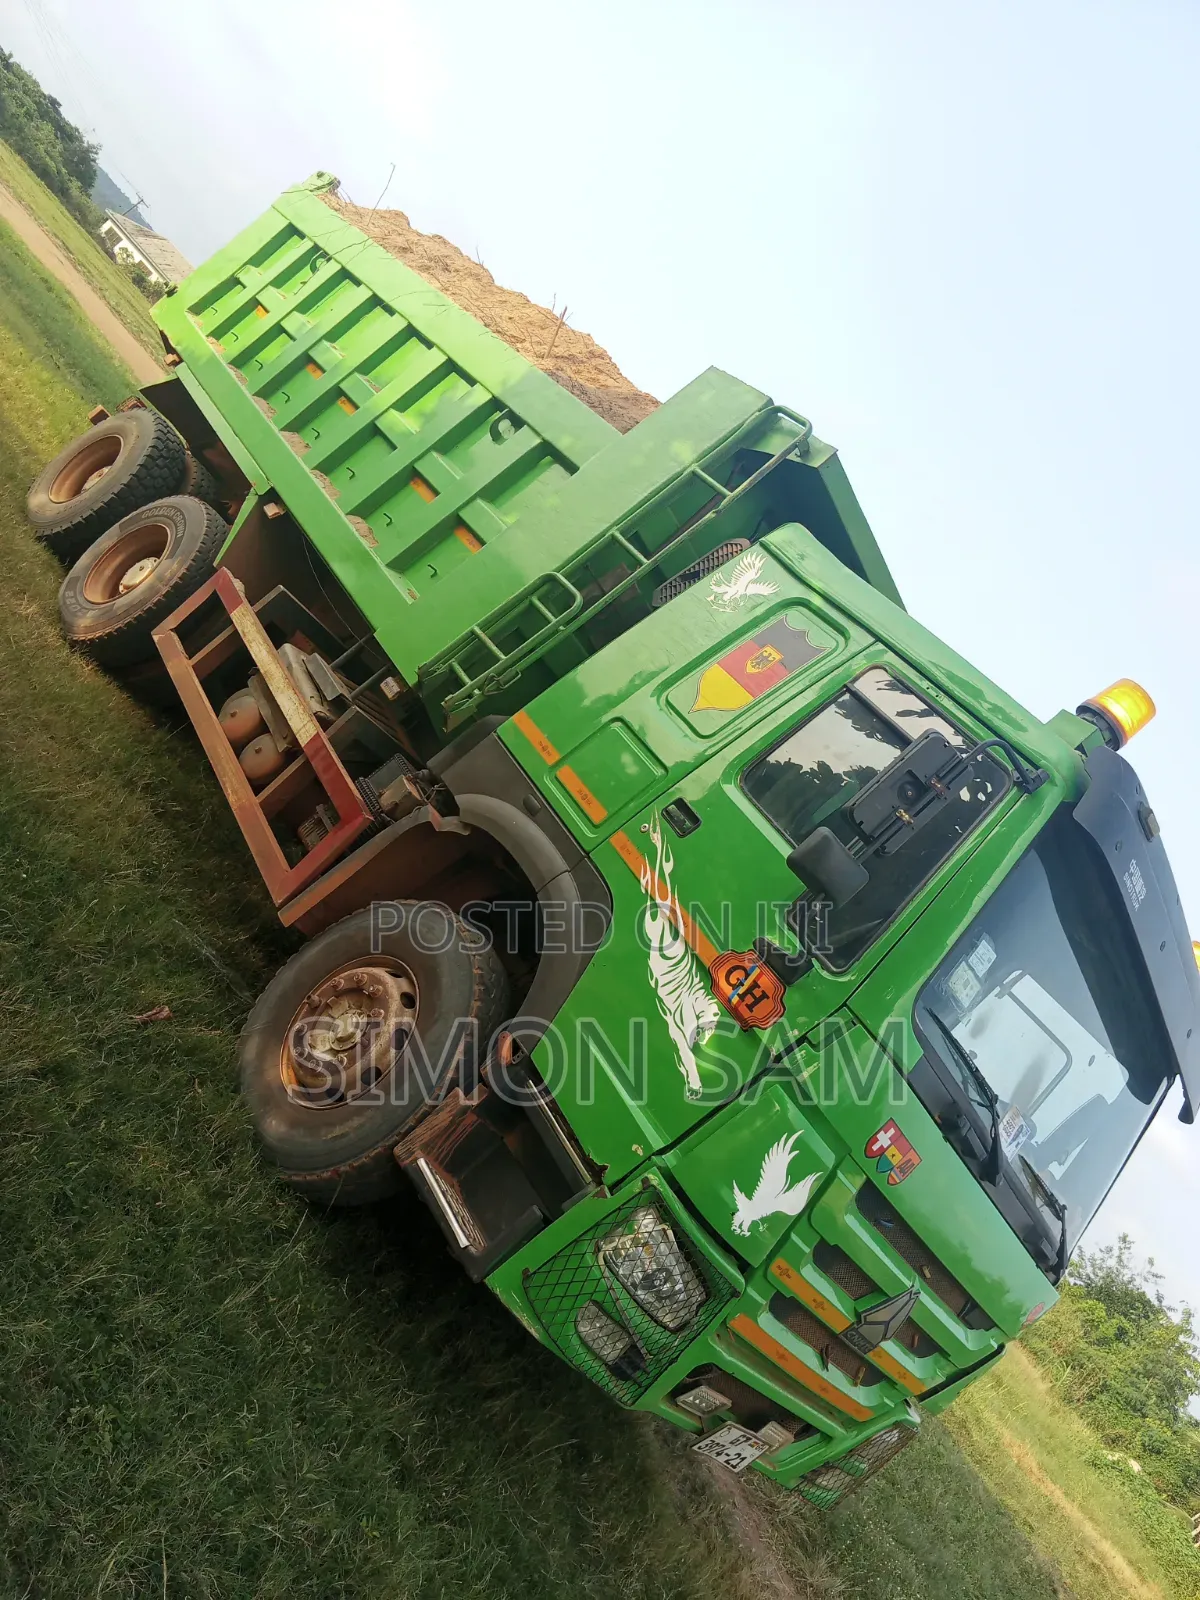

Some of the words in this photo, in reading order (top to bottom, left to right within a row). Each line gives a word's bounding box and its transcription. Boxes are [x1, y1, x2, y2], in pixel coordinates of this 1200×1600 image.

[141, 507, 177, 518] GOLDEN
[172, 512, 185, 538] CROWN
[725, 965, 770, 1013] GH
